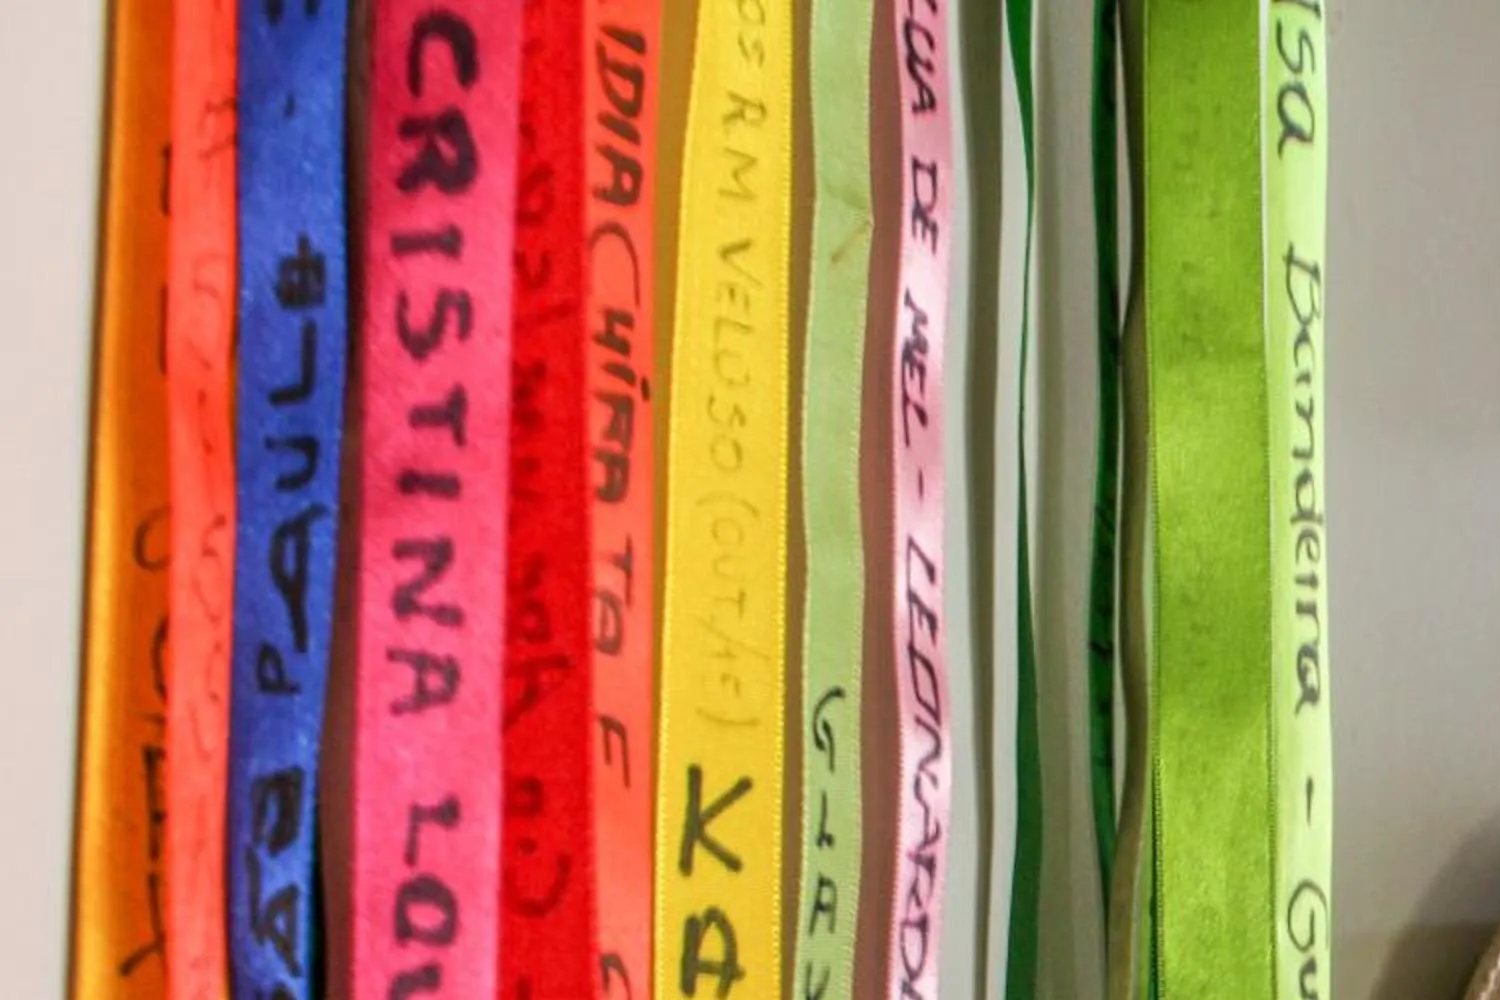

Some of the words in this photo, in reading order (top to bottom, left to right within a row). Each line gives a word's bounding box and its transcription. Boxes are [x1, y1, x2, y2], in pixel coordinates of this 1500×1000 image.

[388, 4, 480, 720] CRISTINA
[910, 154, 940, 258] DE
[901, 288, 931, 450] MEL
[1284, 242, 1326, 718] Bandeira
